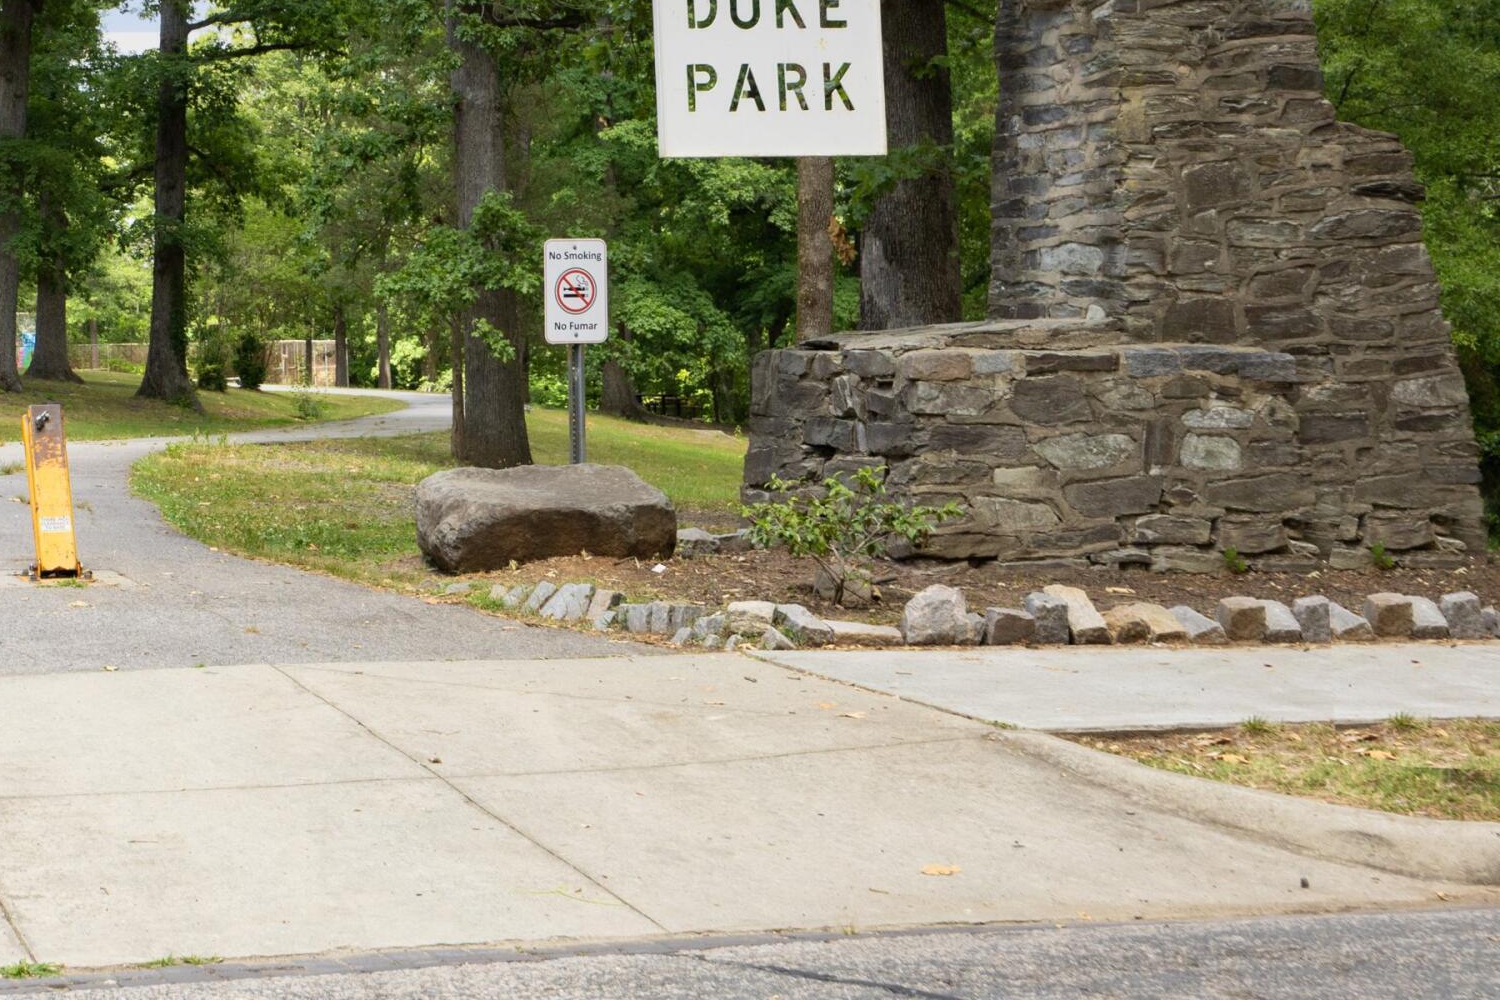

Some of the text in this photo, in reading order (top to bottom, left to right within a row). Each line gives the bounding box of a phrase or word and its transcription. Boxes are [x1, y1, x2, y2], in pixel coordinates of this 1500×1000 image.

[686, 62, 856, 113] PARK
[549, 251, 602, 261] No Smoking
[554, 321, 598, 331] No Fumar
